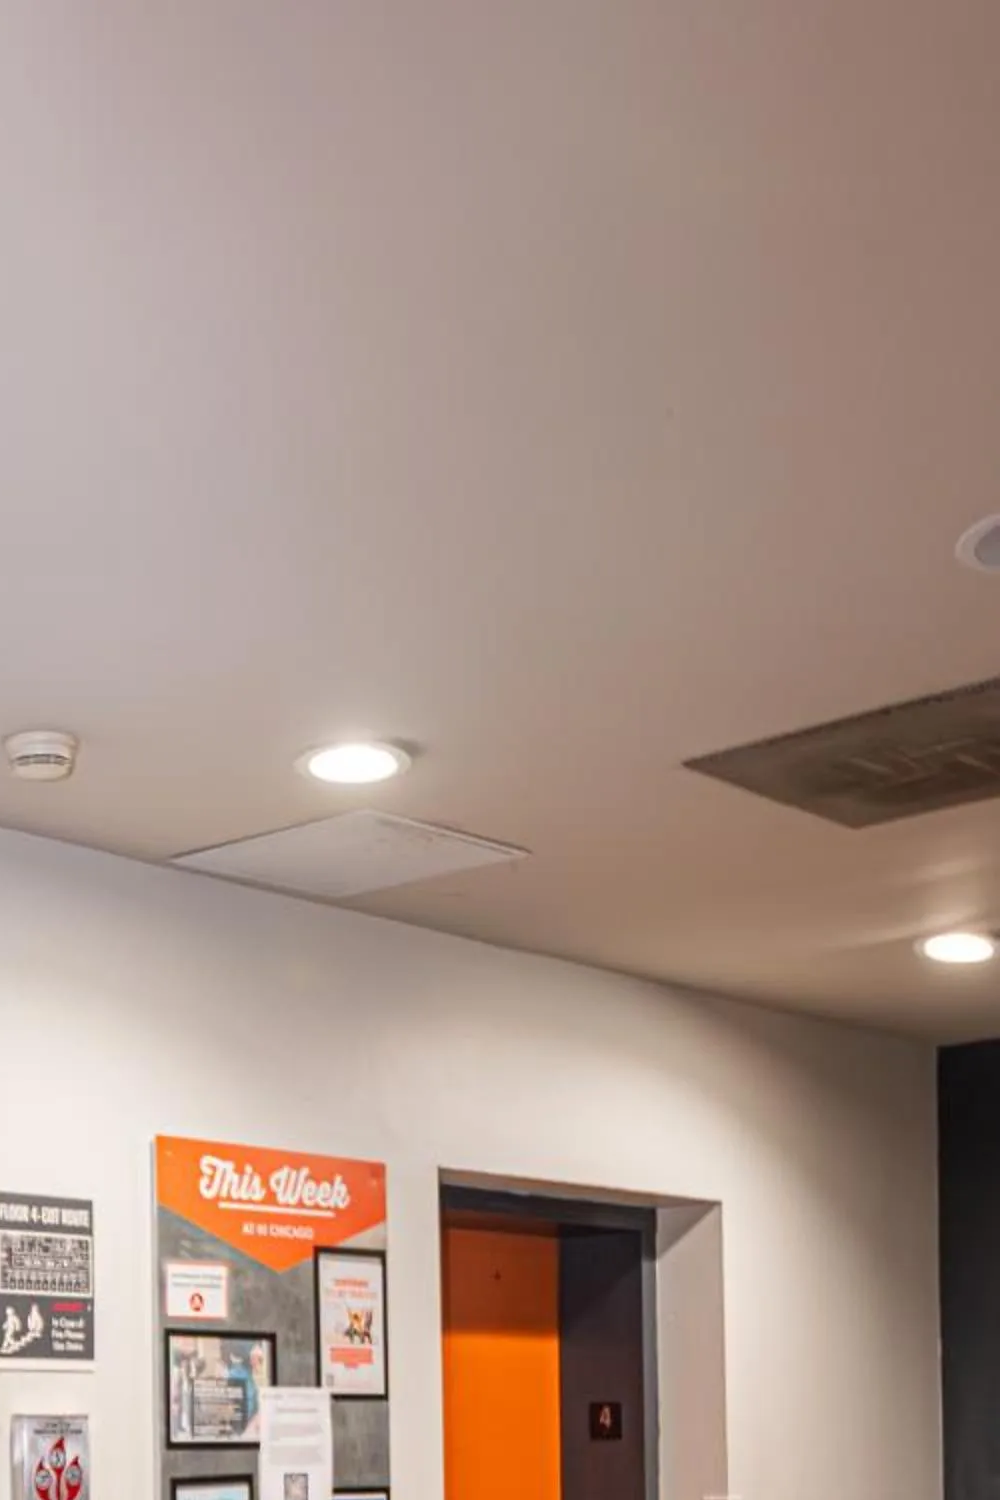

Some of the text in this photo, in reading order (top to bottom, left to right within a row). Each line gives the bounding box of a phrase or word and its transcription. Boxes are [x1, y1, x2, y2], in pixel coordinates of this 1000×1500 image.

[199, 1154, 350, 1209] This Week
[0, 1202, 28, 1222] FLOOR
[599, 1406, 611, 1429] 4
